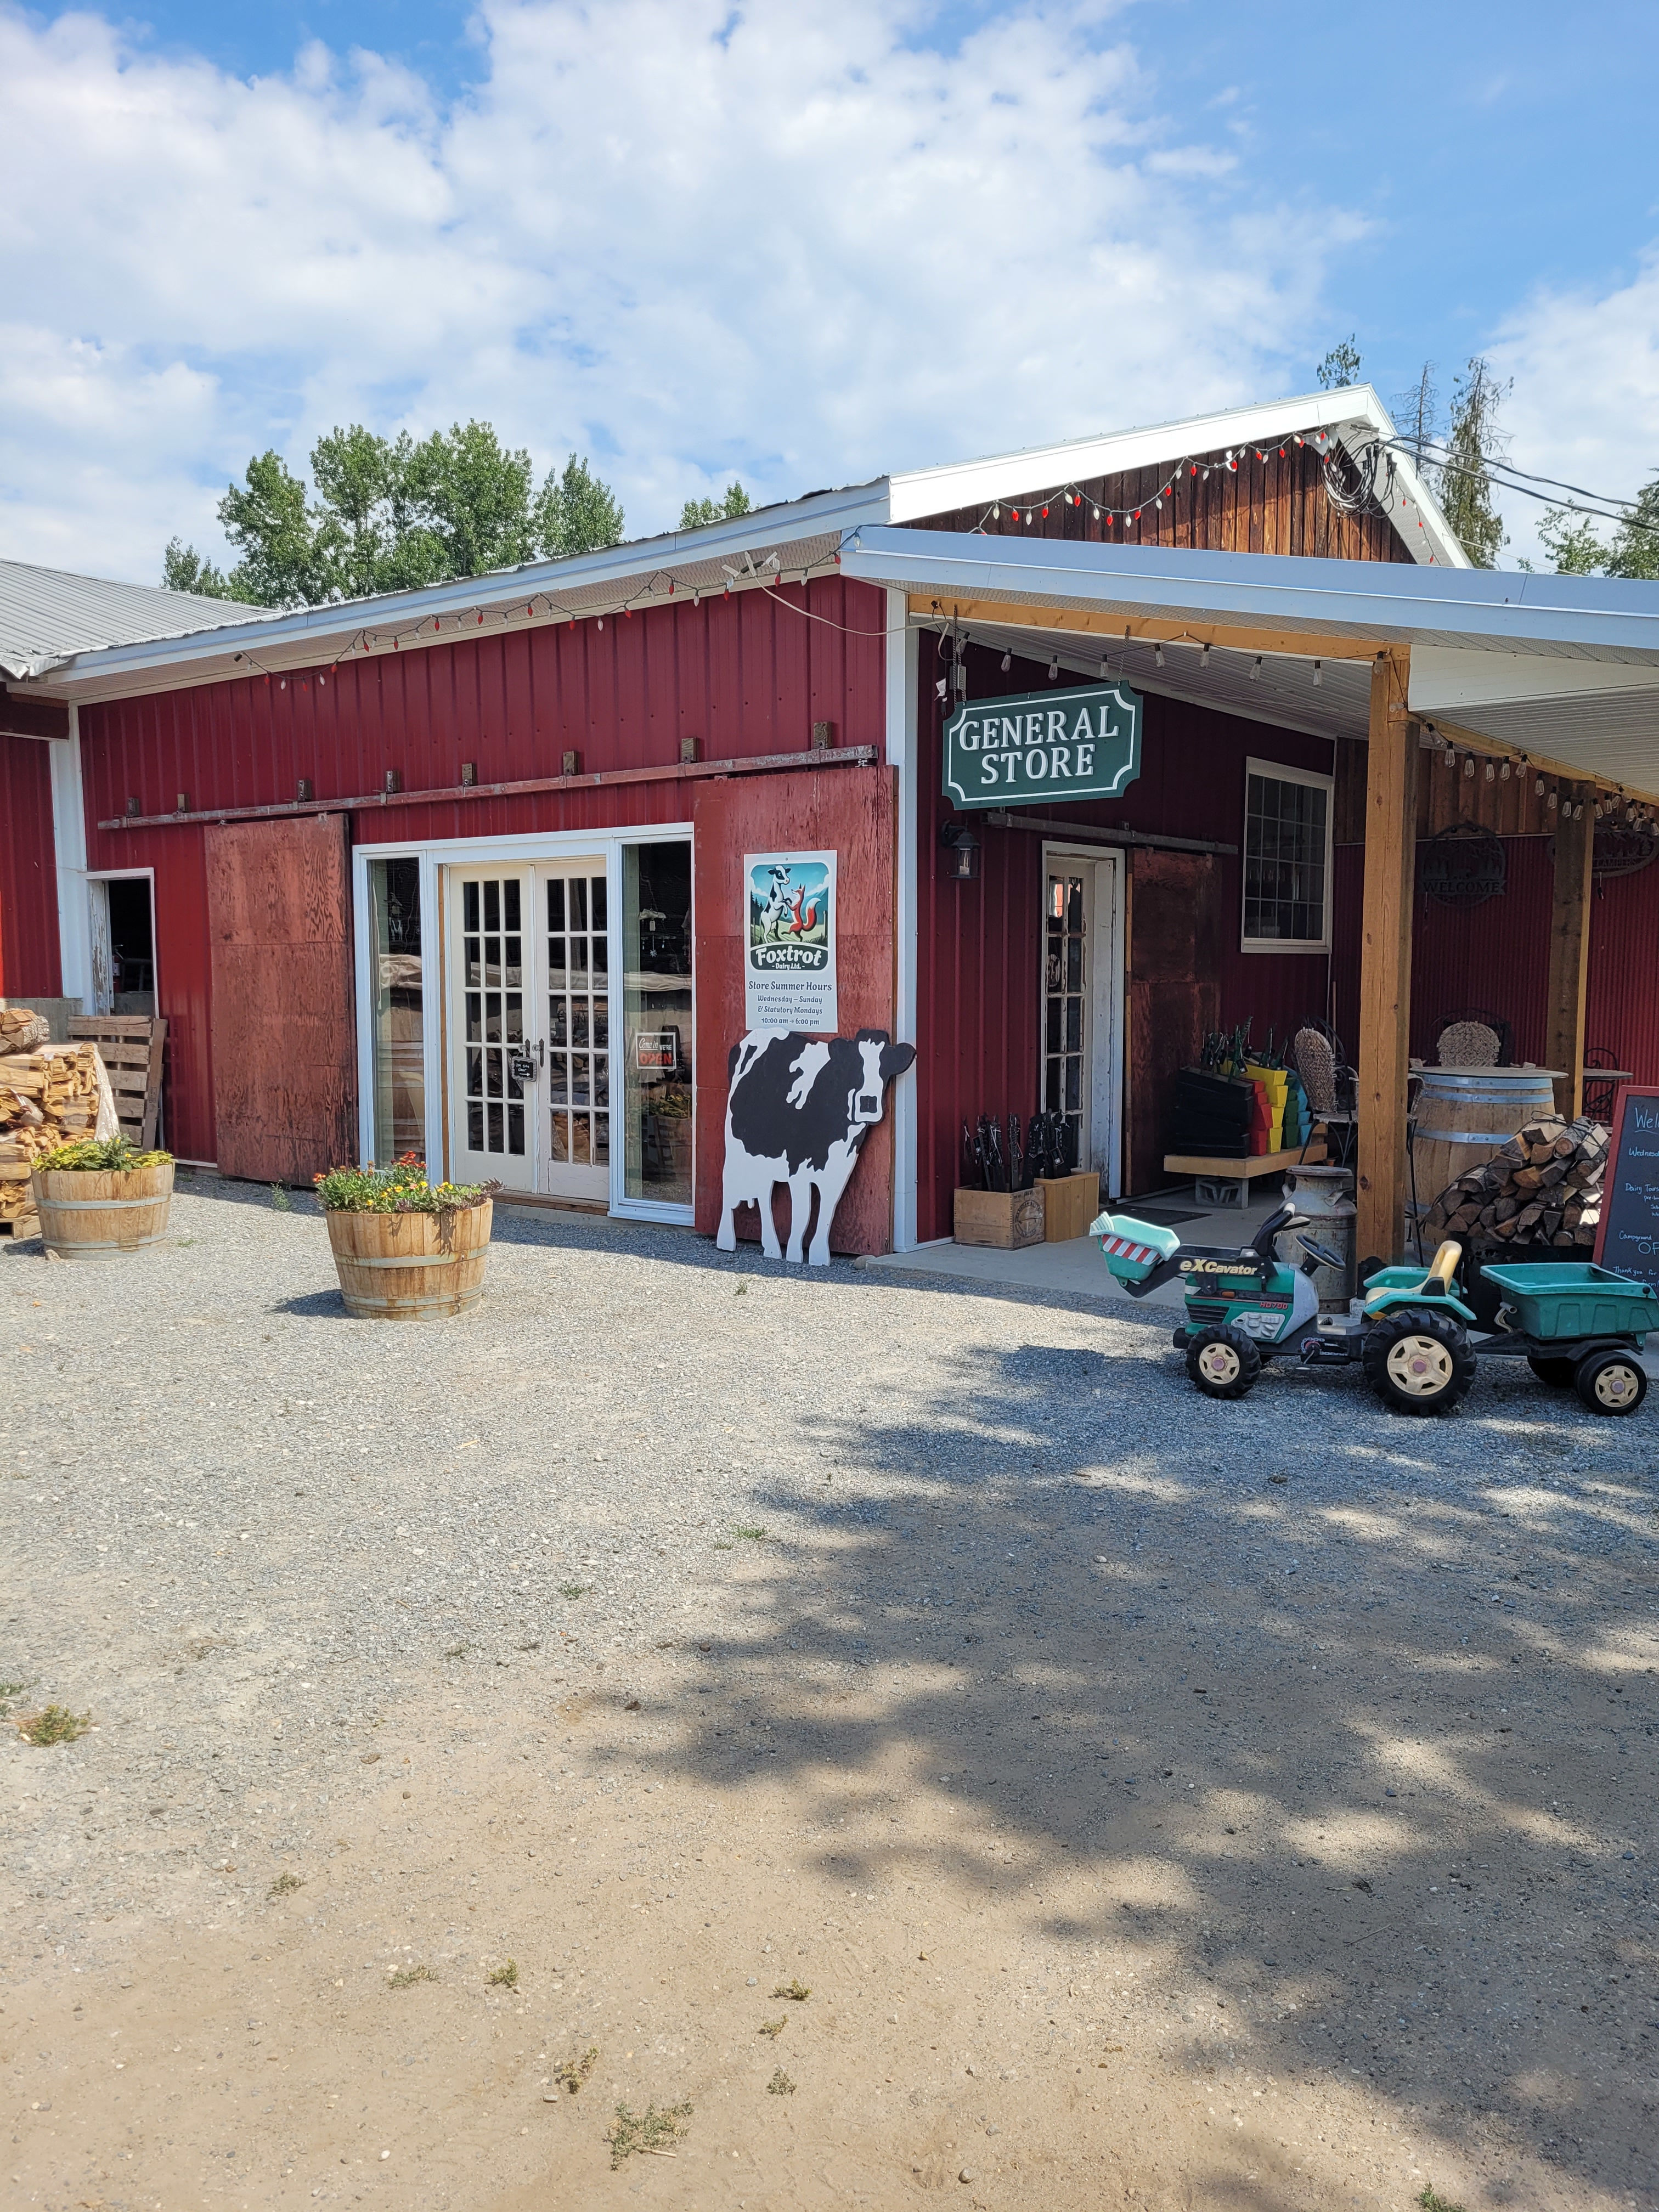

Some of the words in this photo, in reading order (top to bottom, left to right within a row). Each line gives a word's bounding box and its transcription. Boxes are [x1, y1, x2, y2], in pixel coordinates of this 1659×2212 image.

[959, 706, 1119, 751] GENERAL
[981, 744, 1096, 785] STORE
[1423, 882, 1500, 893] WELCOME
[755, 945, 822, 966] Foxtrot
[748, 980, 769, 990] Store
[771, 981, 805, 990] Summer
[806, 981, 832, 991] Hours
[758, 995, 792, 1004] Wednesday
[799, 996, 822, 1005] Sunday
[764, 1006, 793, 1014] Statutory
[794, 1006, 823, 1015] Mondays
[639, 1037, 652, 1049] Come
[653, 1040, 659, 1049] in
[639, 1053, 672, 1064] OPEN
[1634, 1107, 1659, 1128] Wel
[1624, 1183, 1642, 1194] Dairy
[1645, 1184, 1659, 1192] Tours
[1180, 1259, 1258, 1275] eXCavator
[1612, 1266, 1633, 1274] Thank
